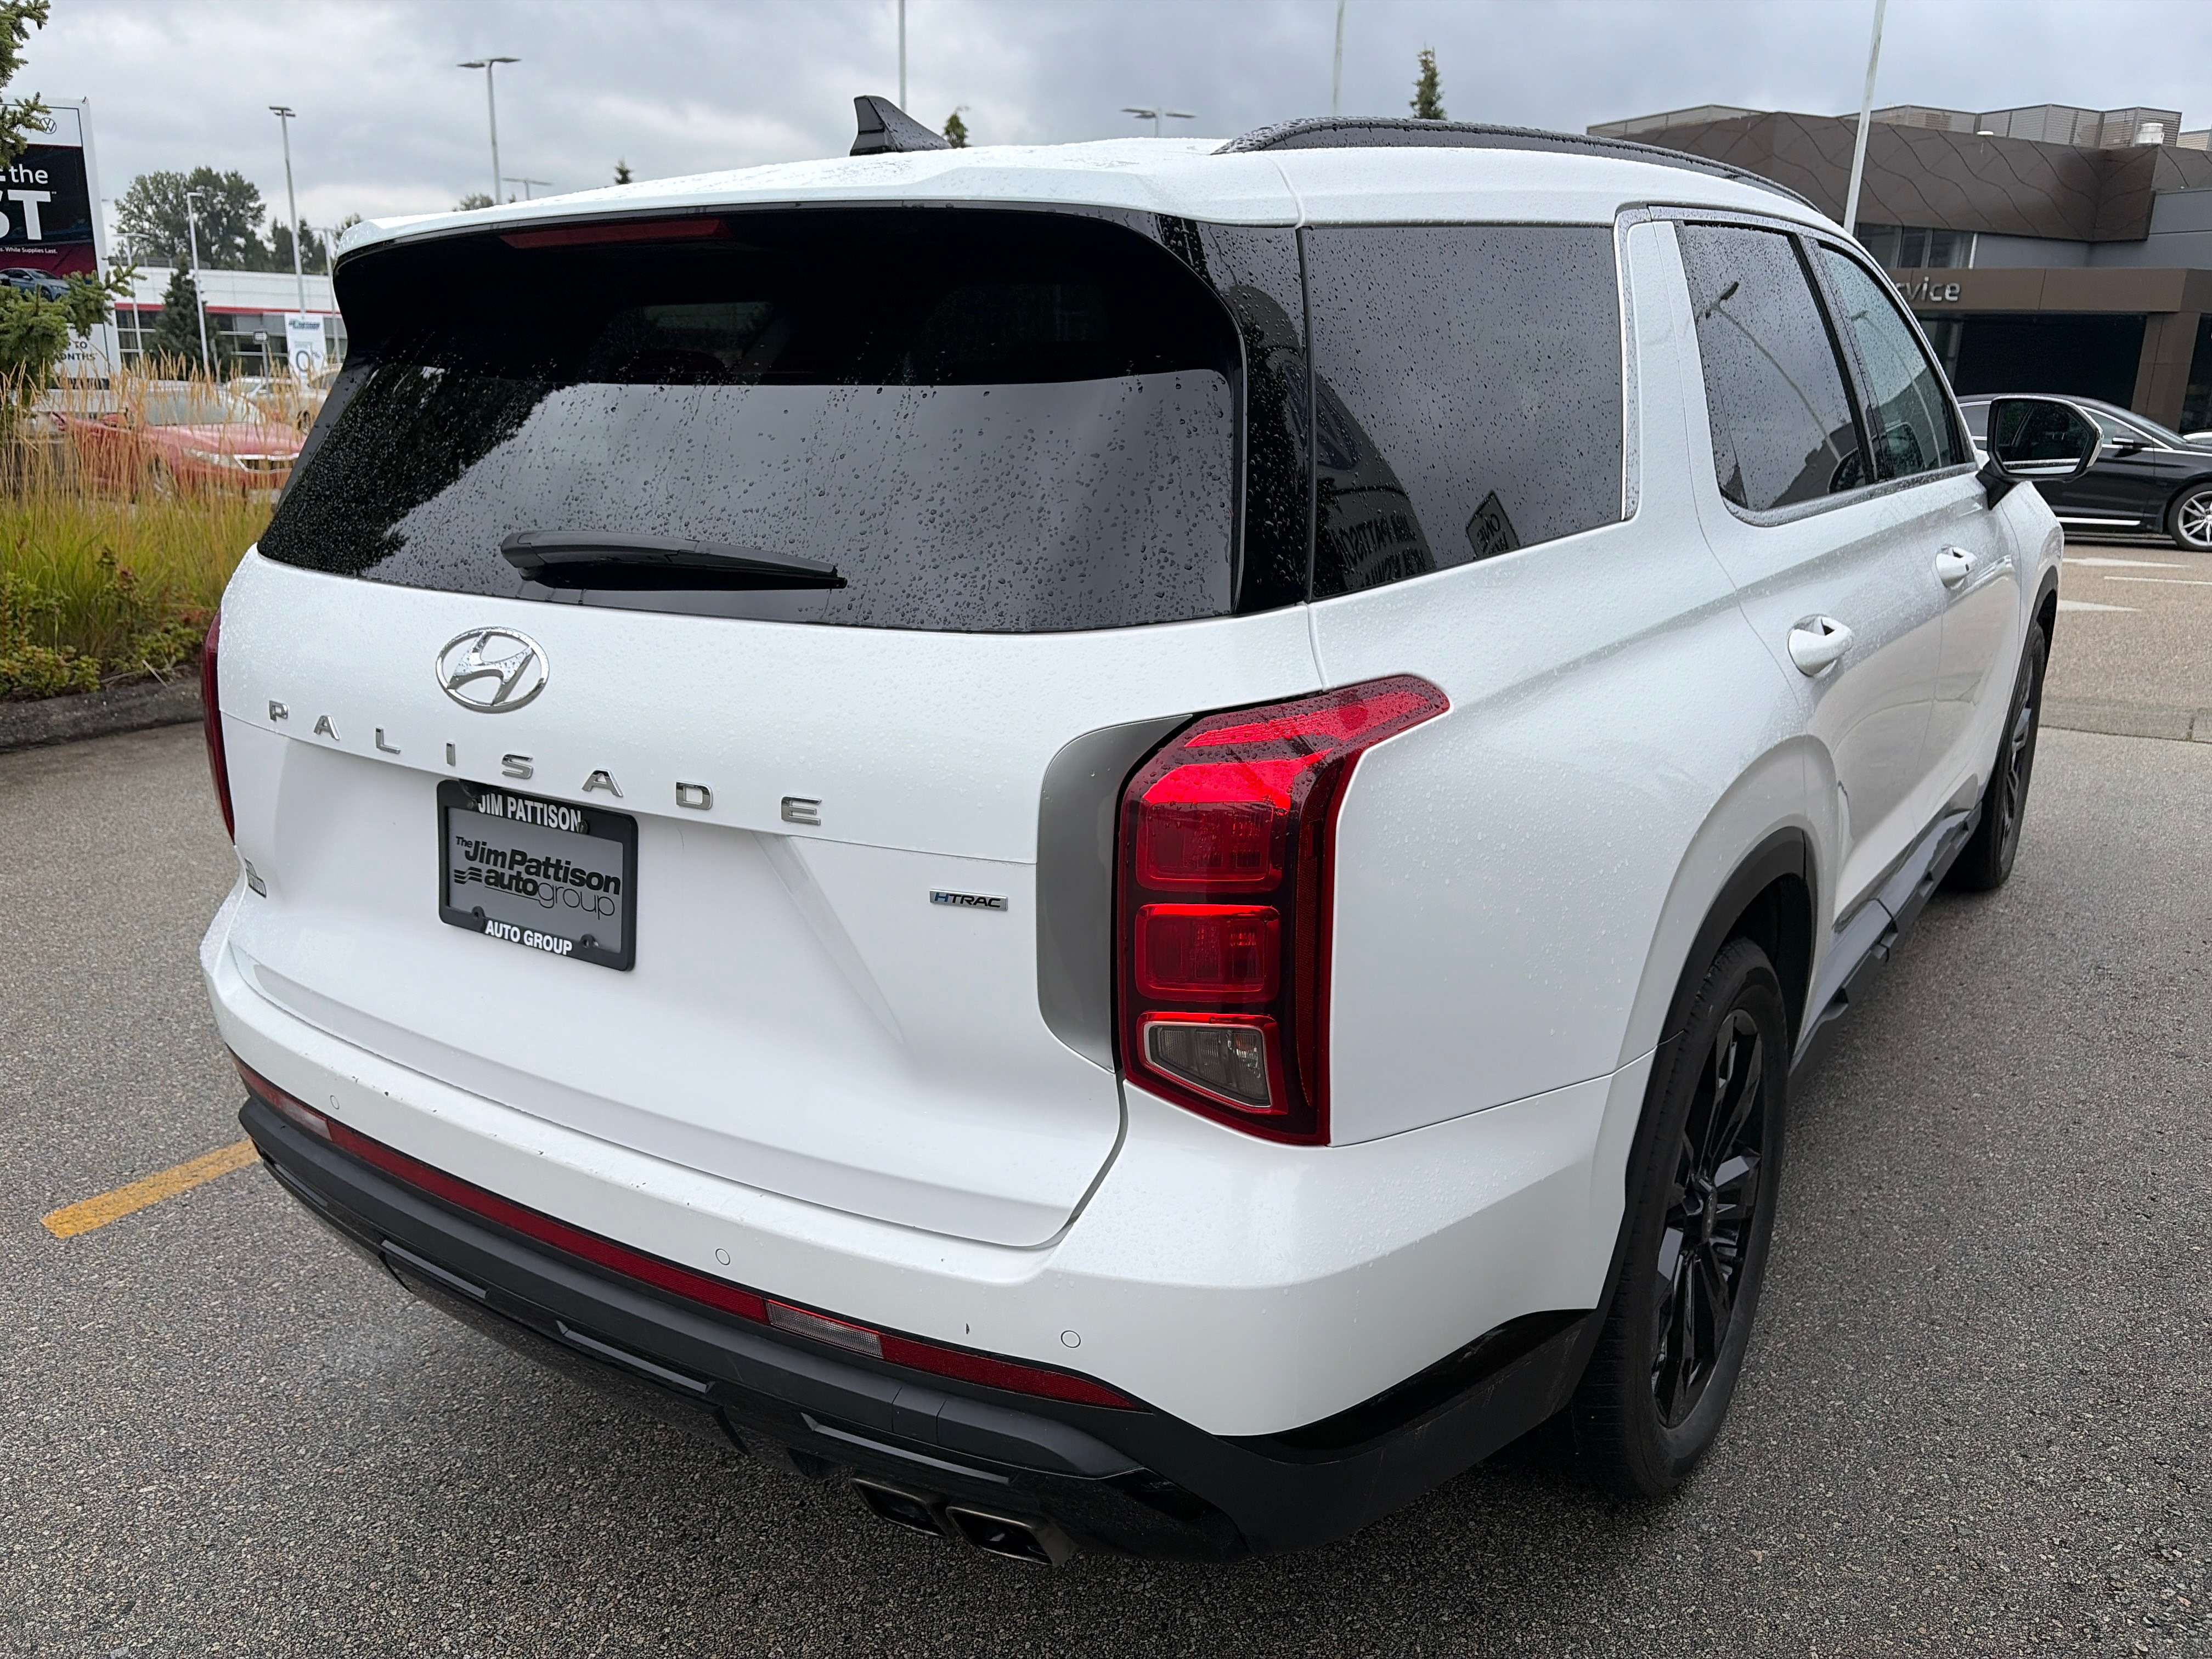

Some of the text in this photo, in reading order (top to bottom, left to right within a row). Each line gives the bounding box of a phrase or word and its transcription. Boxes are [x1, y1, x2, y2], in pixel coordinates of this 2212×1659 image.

[9, 163, 48, 184] the
[268, 699, 822, 826] PALISADE
[478, 793, 582, 832] JIM PATTISON
[456, 836, 473, 848] The
[934, 892, 1001, 908] HTRAC
[485, 920, 573, 956] AUTO GROUP
